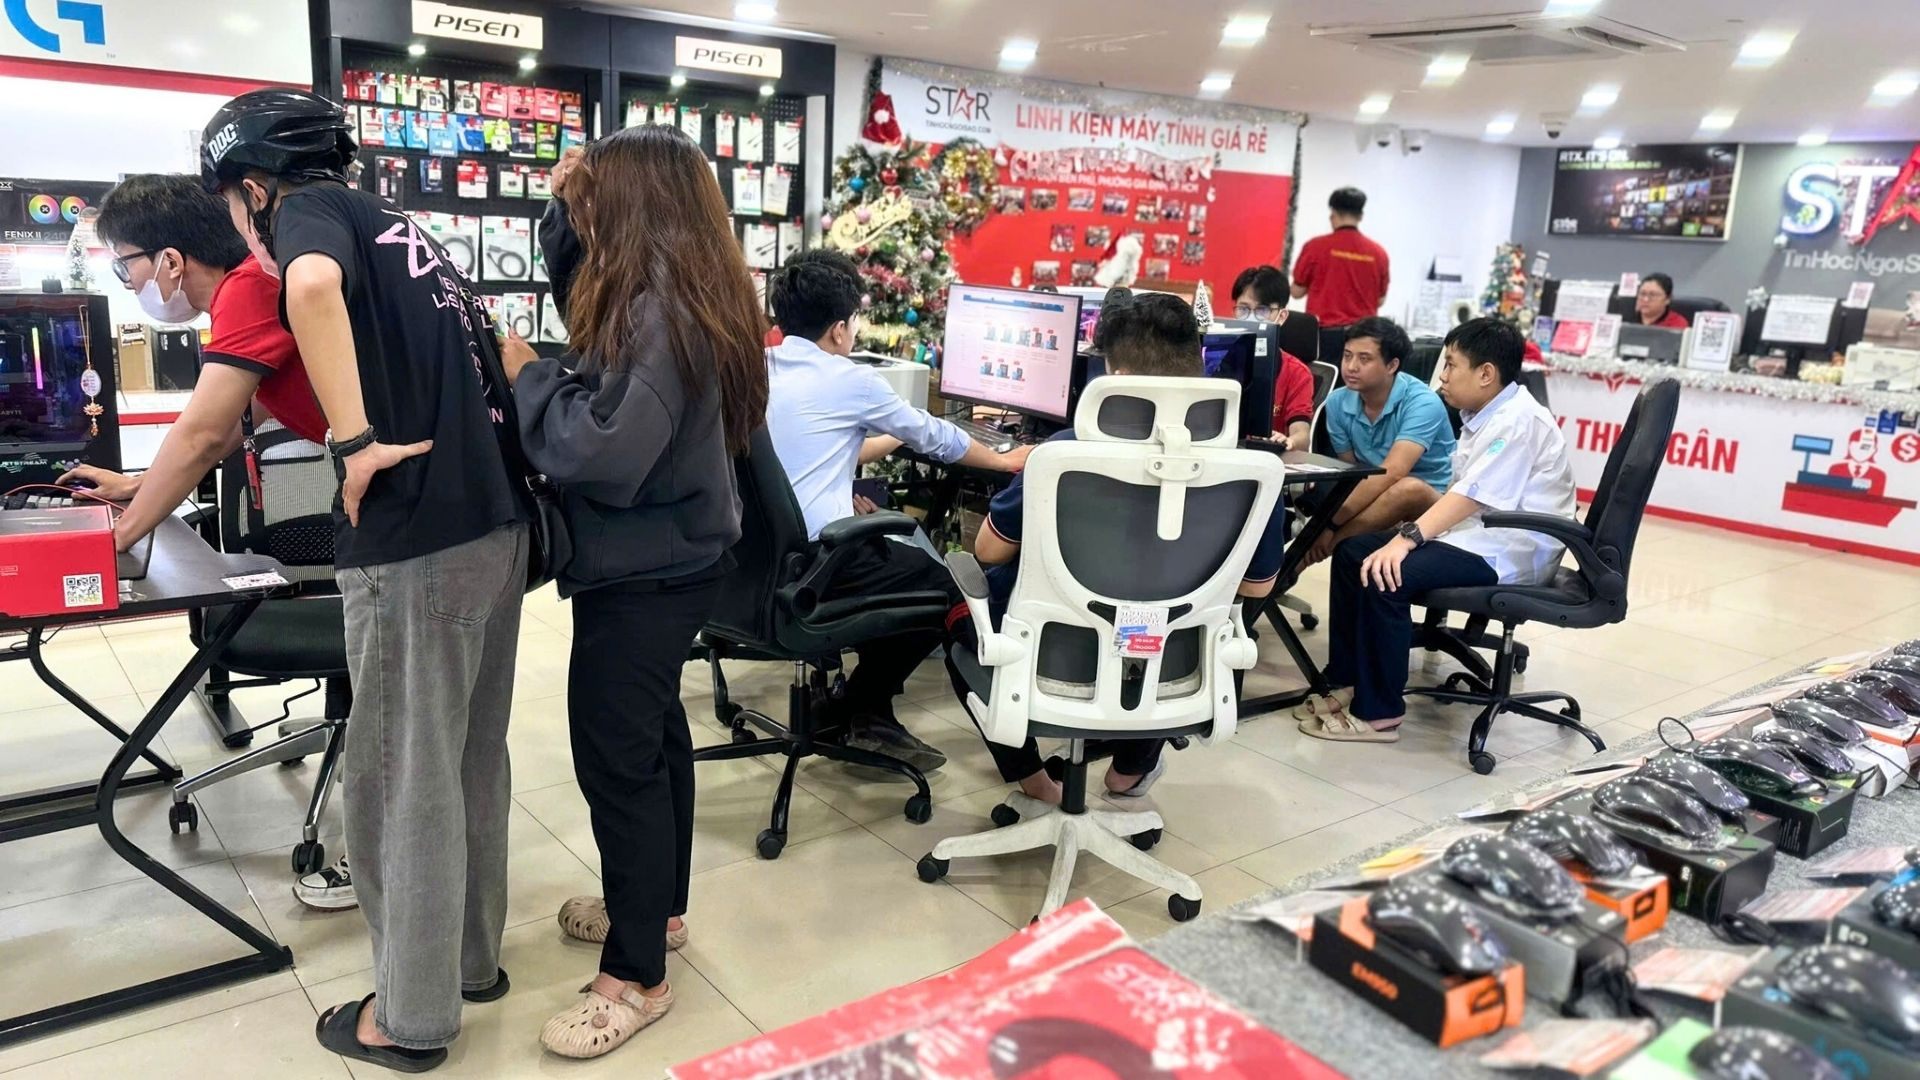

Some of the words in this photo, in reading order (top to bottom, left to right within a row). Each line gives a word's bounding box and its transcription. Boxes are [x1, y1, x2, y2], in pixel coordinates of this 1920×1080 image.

[434, 14, 520, 38] PISEN
[694, 48, 763, 67] PISEN
[1016, 104, 1063, 132] LINH
[1119, 113, 1160, 142] MÁY
[1166, 117, 1205, 146] TÍNH
[1211, 124, 1241, 150] GIÁ
[4, 231, 34, 239] FENIX
[1665, 428, 1739, 474] GÂN
